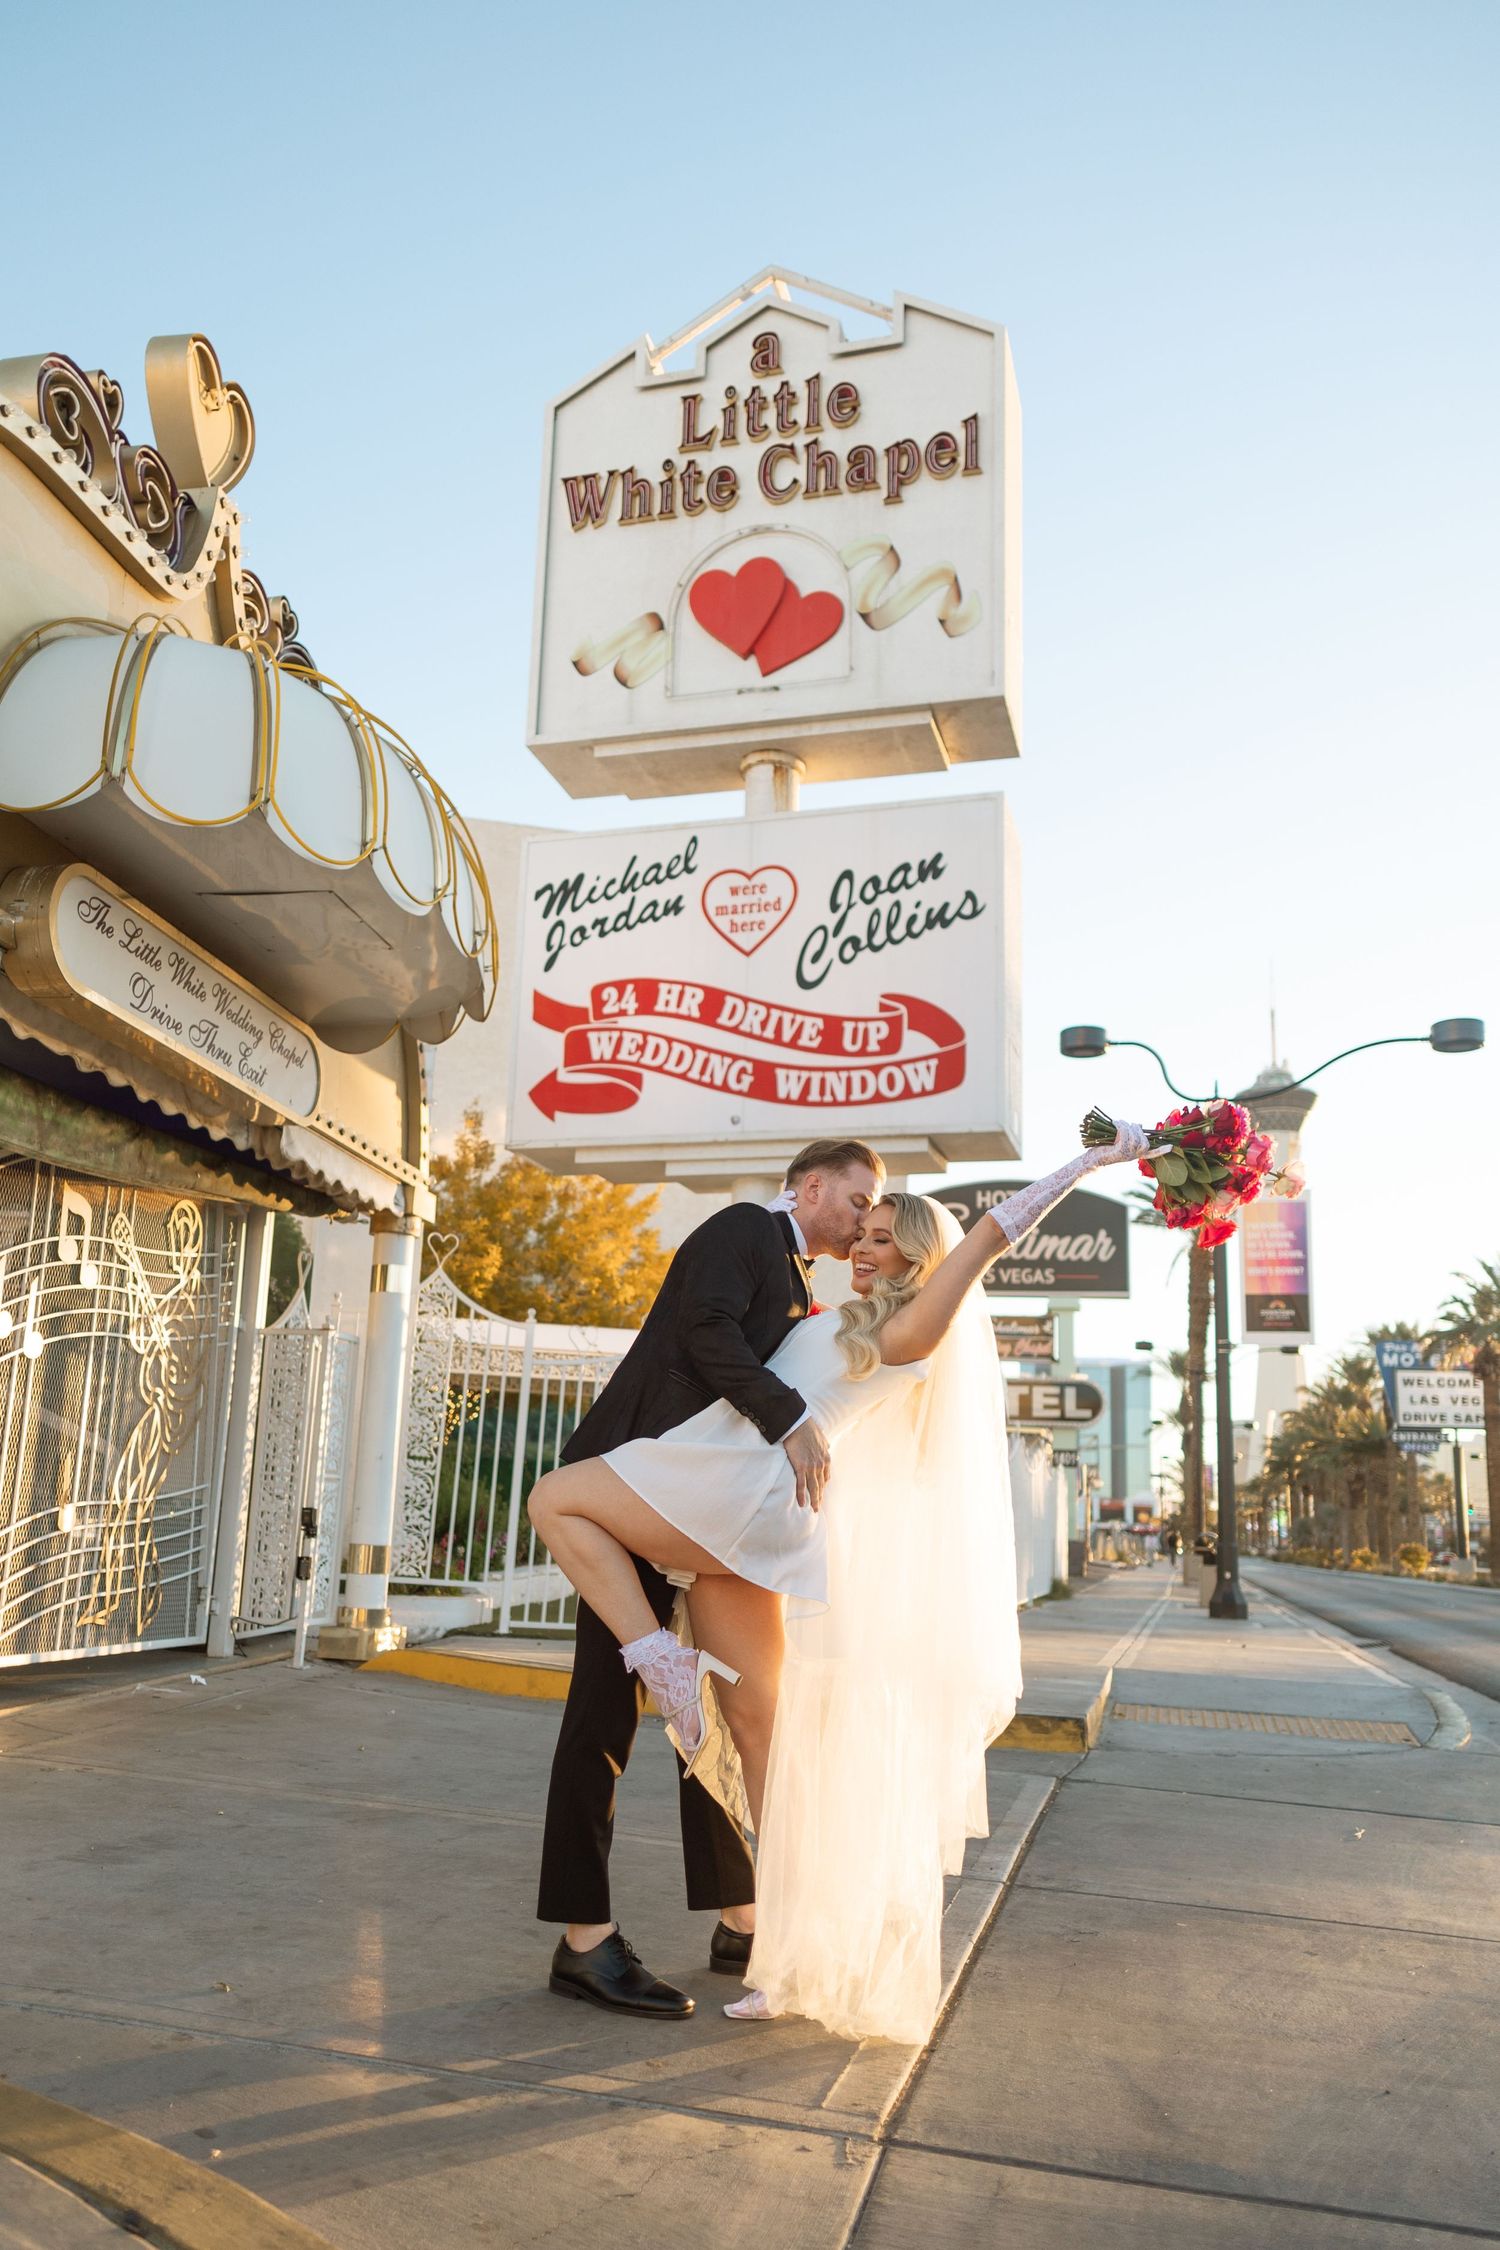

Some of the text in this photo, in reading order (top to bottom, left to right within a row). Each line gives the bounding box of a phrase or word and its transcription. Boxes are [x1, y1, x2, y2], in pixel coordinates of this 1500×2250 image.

[750, 331, 784, 378] a
[678, 373, 860, 453] Little
[562, 413, 982, 532] White Chapel
[534, 835, 699, 919] Michael
[715, 897, 782, 915] married
[730, 881, 767, 895] were
[830, 852, 947, 937] Joan
[544, 894, 685, 972] Jordan
[730, 917, 766, 933] here
[796, 890, 986, 990] Collins
[77, 897, 307, 1069] The Little White Wedding Chapel
[600, 982, 890, 1052] 24 HR DRIVE UP
[129, 972, 268, 1087] Drive Thru Exit
[587, 1031, 938, 1102] WEDDING WINDOW
[999, 1267, 1055, 1285] VEGAS
[1007, 1385, 1093, 1419] TEL
[1402, 1412, 1447, 1423] DRIVE
[1403, 1377, 1481, 1388] WELCOME
[1410, 1395, 1481, 1406] LAS VEG
